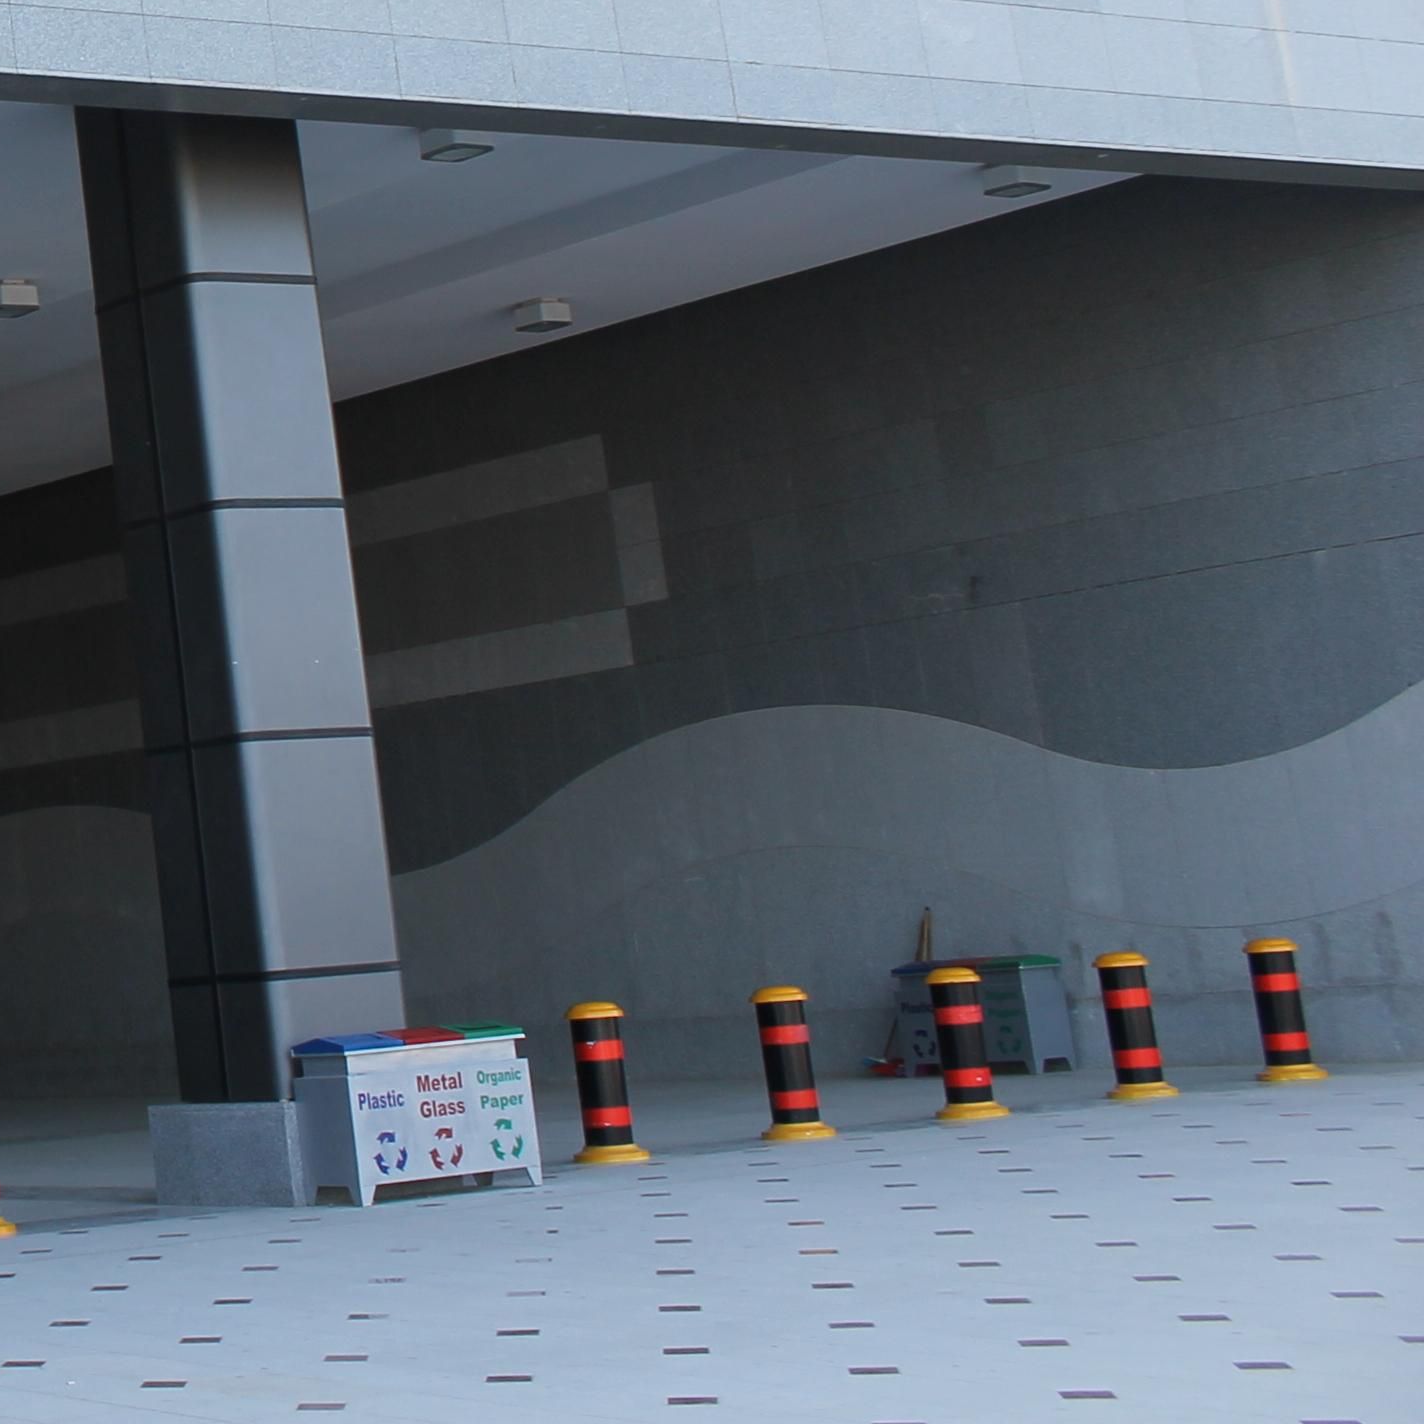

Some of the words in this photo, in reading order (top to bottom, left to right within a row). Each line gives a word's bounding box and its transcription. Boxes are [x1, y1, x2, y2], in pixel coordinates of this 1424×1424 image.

[416, 1072, 463, 1093] Metal
[476, 1068, 522, 1086] Organic
[357, 1089, 404, 1111] Plastic
[420, 1099, 466, 1118] Glass
[480, 1093, 524, 1111] Paper
